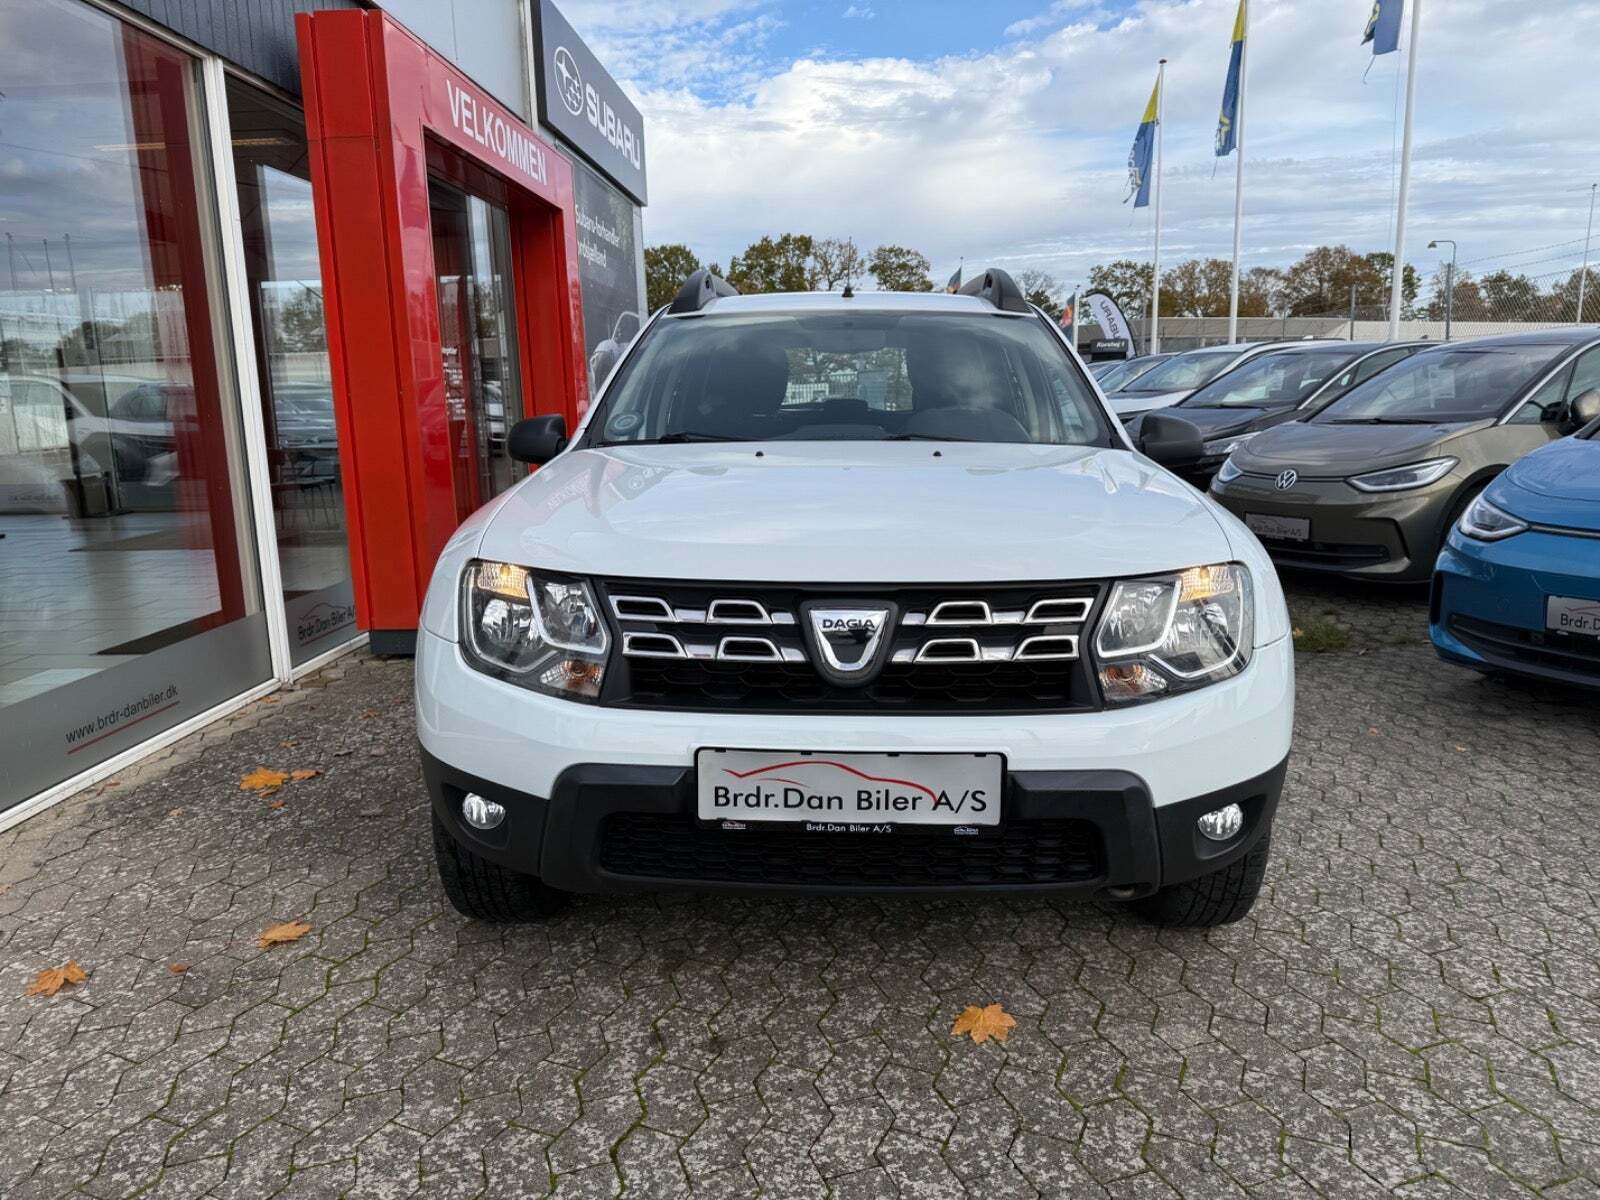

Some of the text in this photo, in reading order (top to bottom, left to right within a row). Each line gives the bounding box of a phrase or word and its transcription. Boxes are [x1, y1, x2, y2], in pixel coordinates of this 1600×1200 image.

[446, 79, 548, 185] VELKOMMEN
[585, 82, 641, 170] SUBARU
[65, 684, 178, 743] www.brdr-danbiler.dk
[849, 824, 870, 832] Biler
[872, 824, 892, 833] A/S
[856, 788, 923, 811] Biler
[931, 790, 987, 813] A/S
